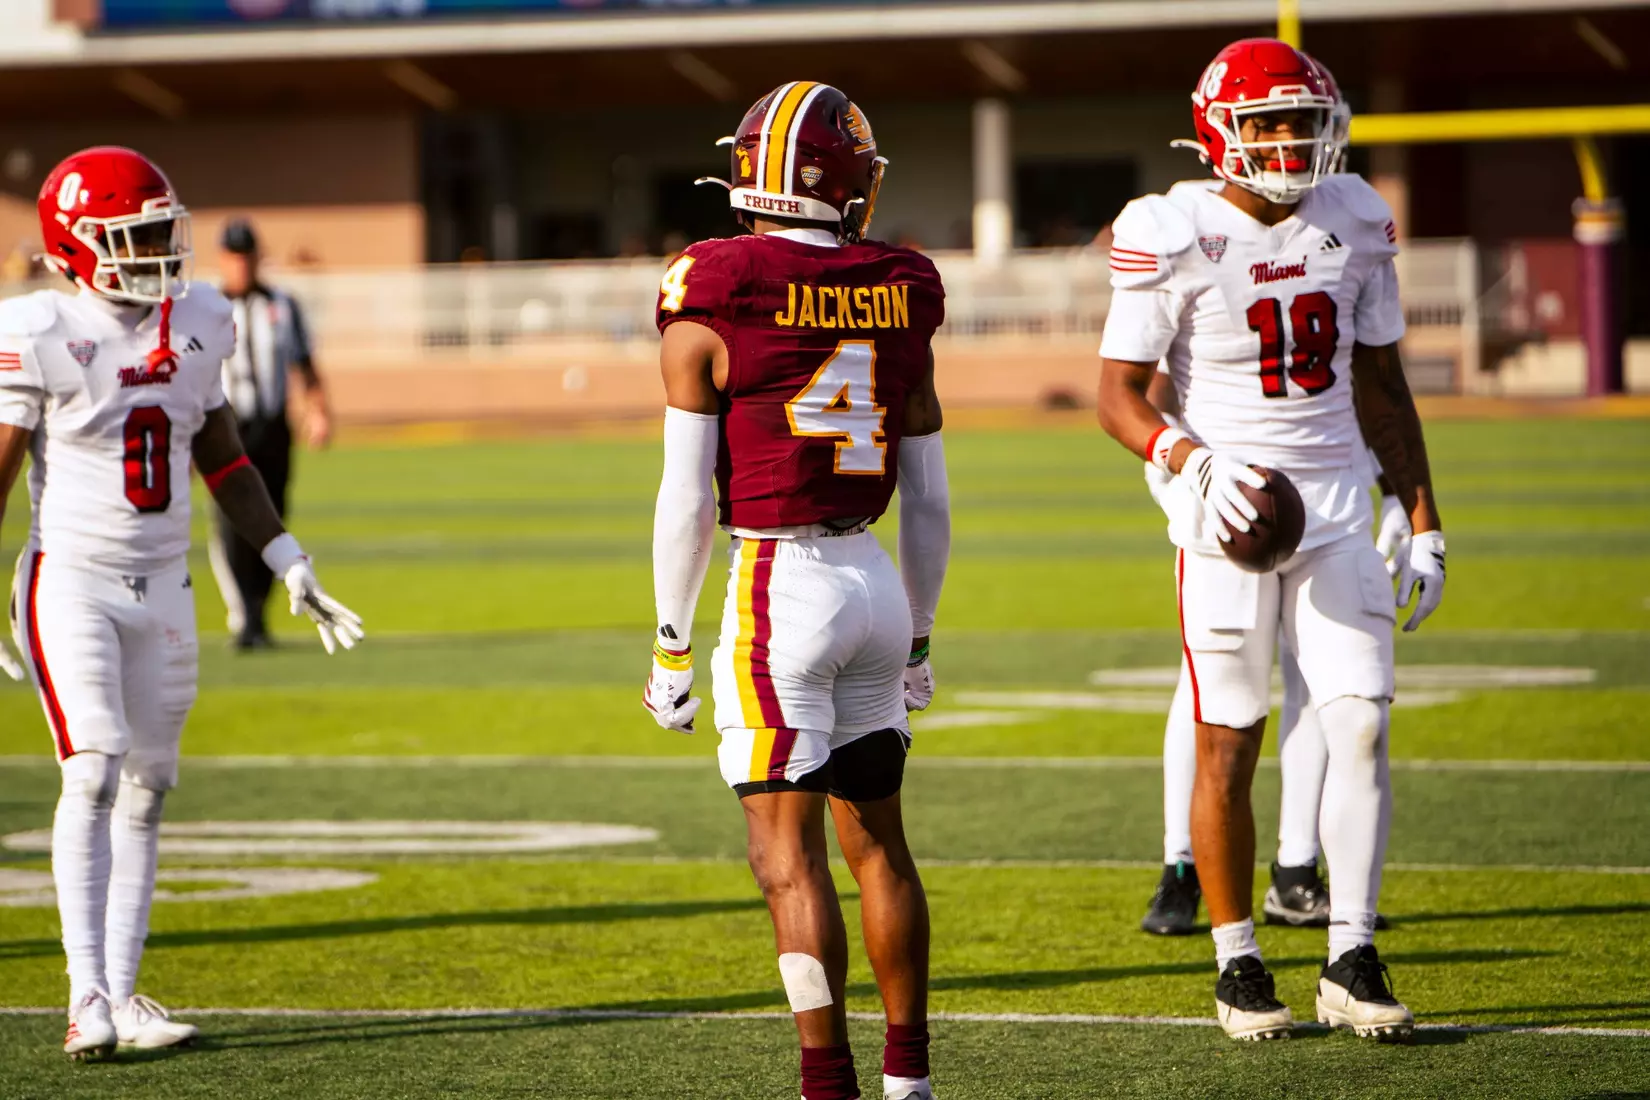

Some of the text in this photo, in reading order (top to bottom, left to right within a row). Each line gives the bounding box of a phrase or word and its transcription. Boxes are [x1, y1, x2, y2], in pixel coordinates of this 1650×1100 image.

[57, 171, 82, 211] 0
[743, 193, 800, 213] TRUTH
[660, 254, 696, 313] 4
[1249, 255, 1307, 285] Miami
[775, 283, 910, 328] JACKSON
[1246, 291, 1338, 398] 18
[784, 339, 887, 475] 4
[123, 405, 172, 513] 0
